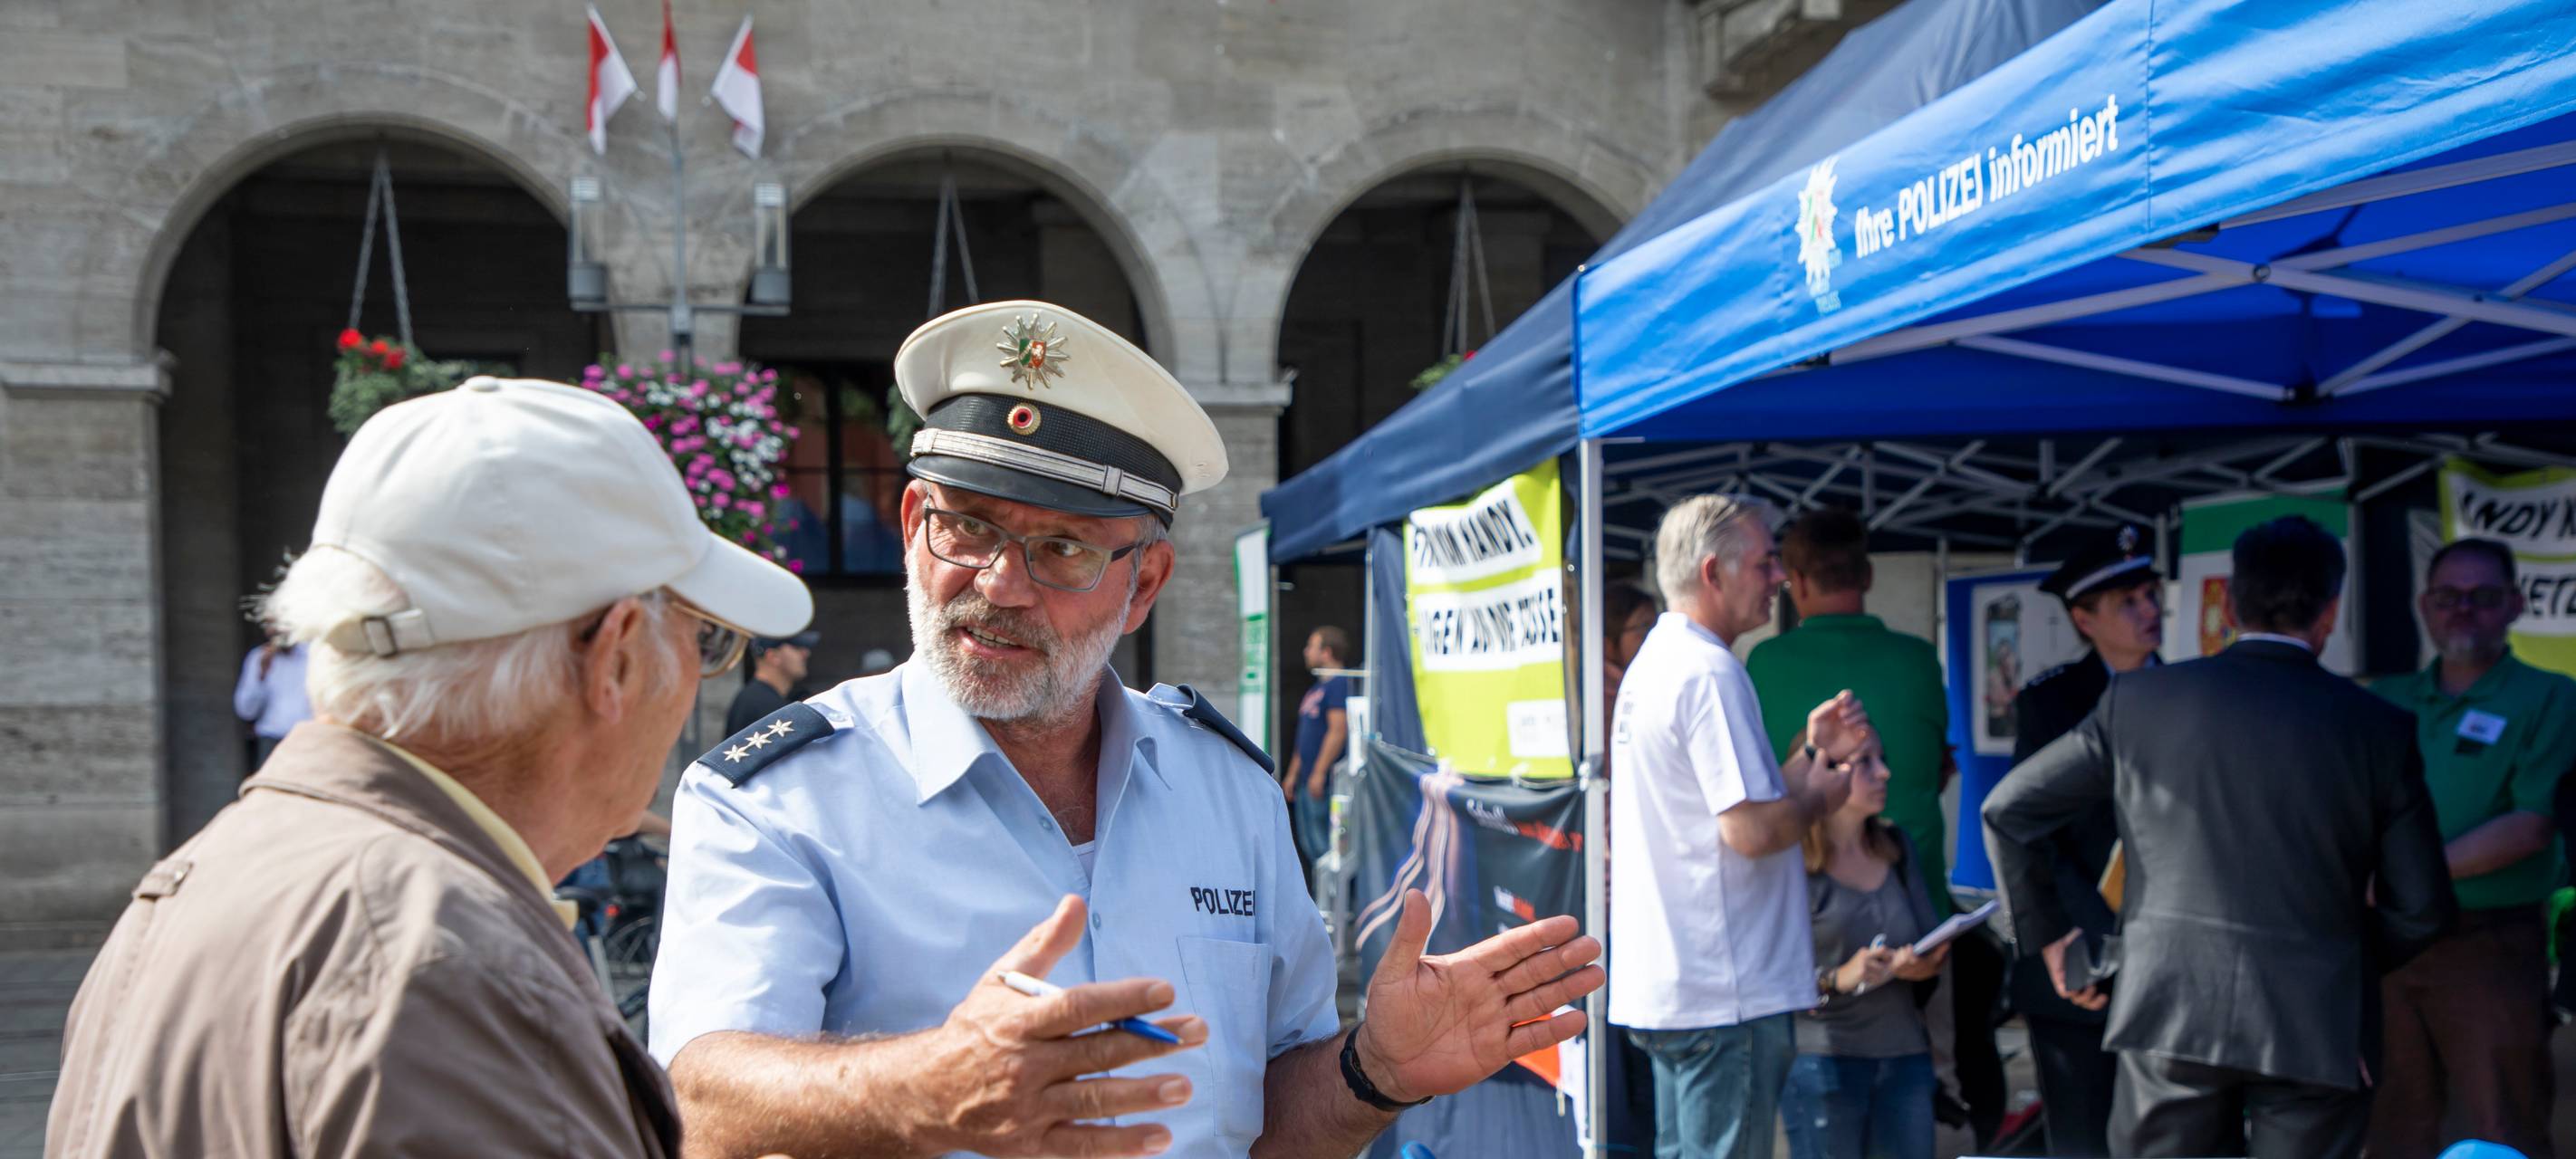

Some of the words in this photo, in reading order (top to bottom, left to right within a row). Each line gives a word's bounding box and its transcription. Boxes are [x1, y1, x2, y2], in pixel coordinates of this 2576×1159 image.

[1854, 206, 1895, 259] Ihre
[1898, 152, 1983, 242] POLIZEI
[1988, 94, 2119, 202] informiert
